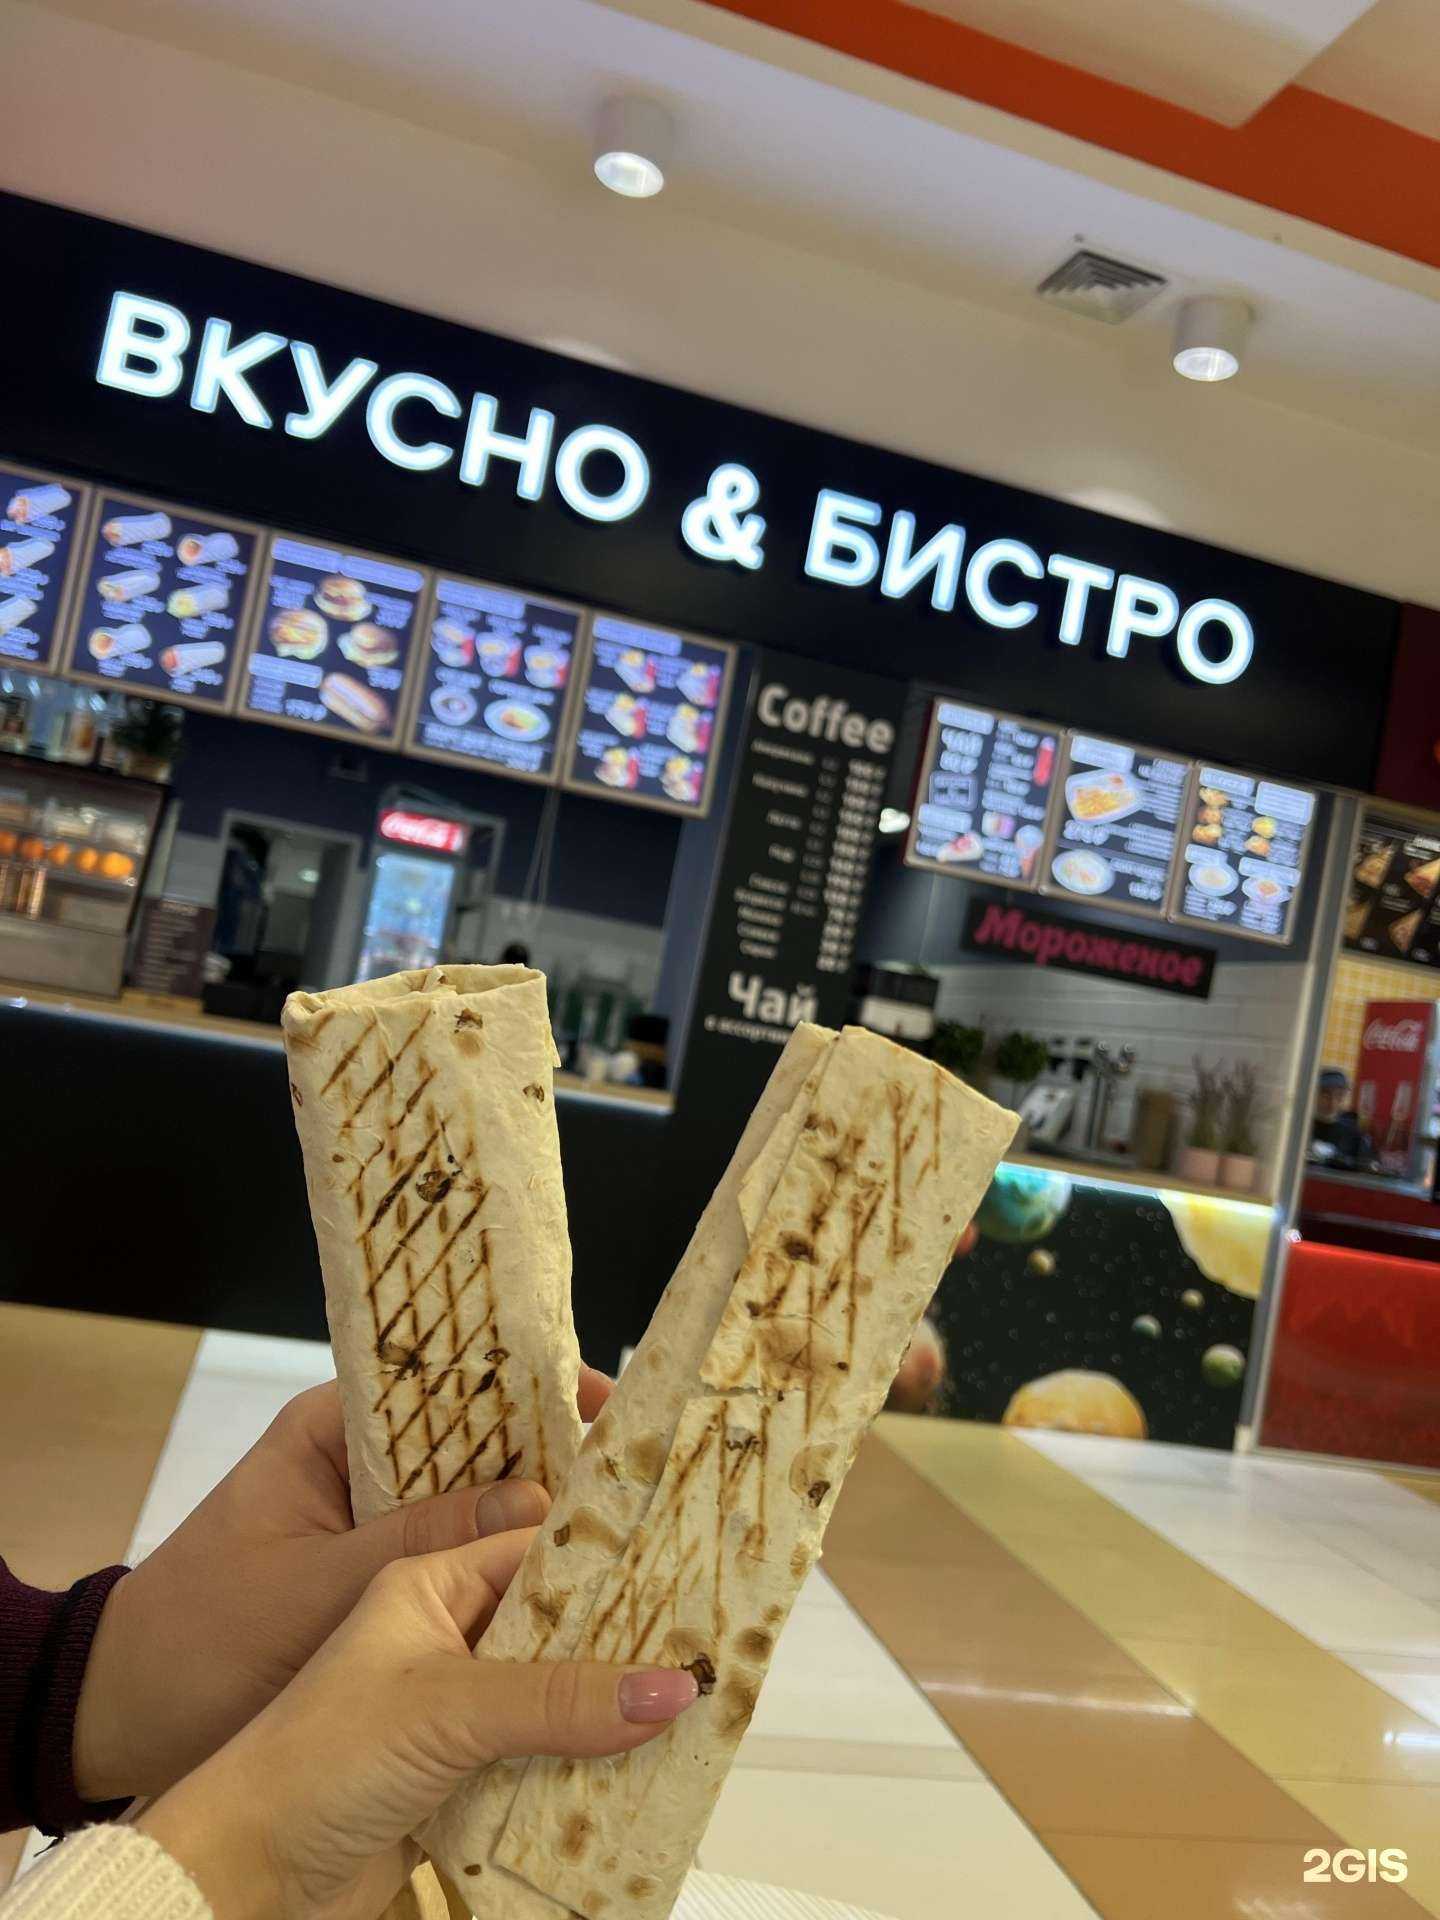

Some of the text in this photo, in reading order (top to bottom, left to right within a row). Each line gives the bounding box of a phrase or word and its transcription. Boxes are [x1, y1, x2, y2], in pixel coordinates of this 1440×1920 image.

[96, 291, 650, 522] ВКУСНО
[682, 463, 766, 570] &
[804, 488, 1254, 685] БИСТРО
[757, 684, 894, 754] Coffee
[974, 906, 1203, 987] Мороженое
[728, 971, 818, 1026] Чай
